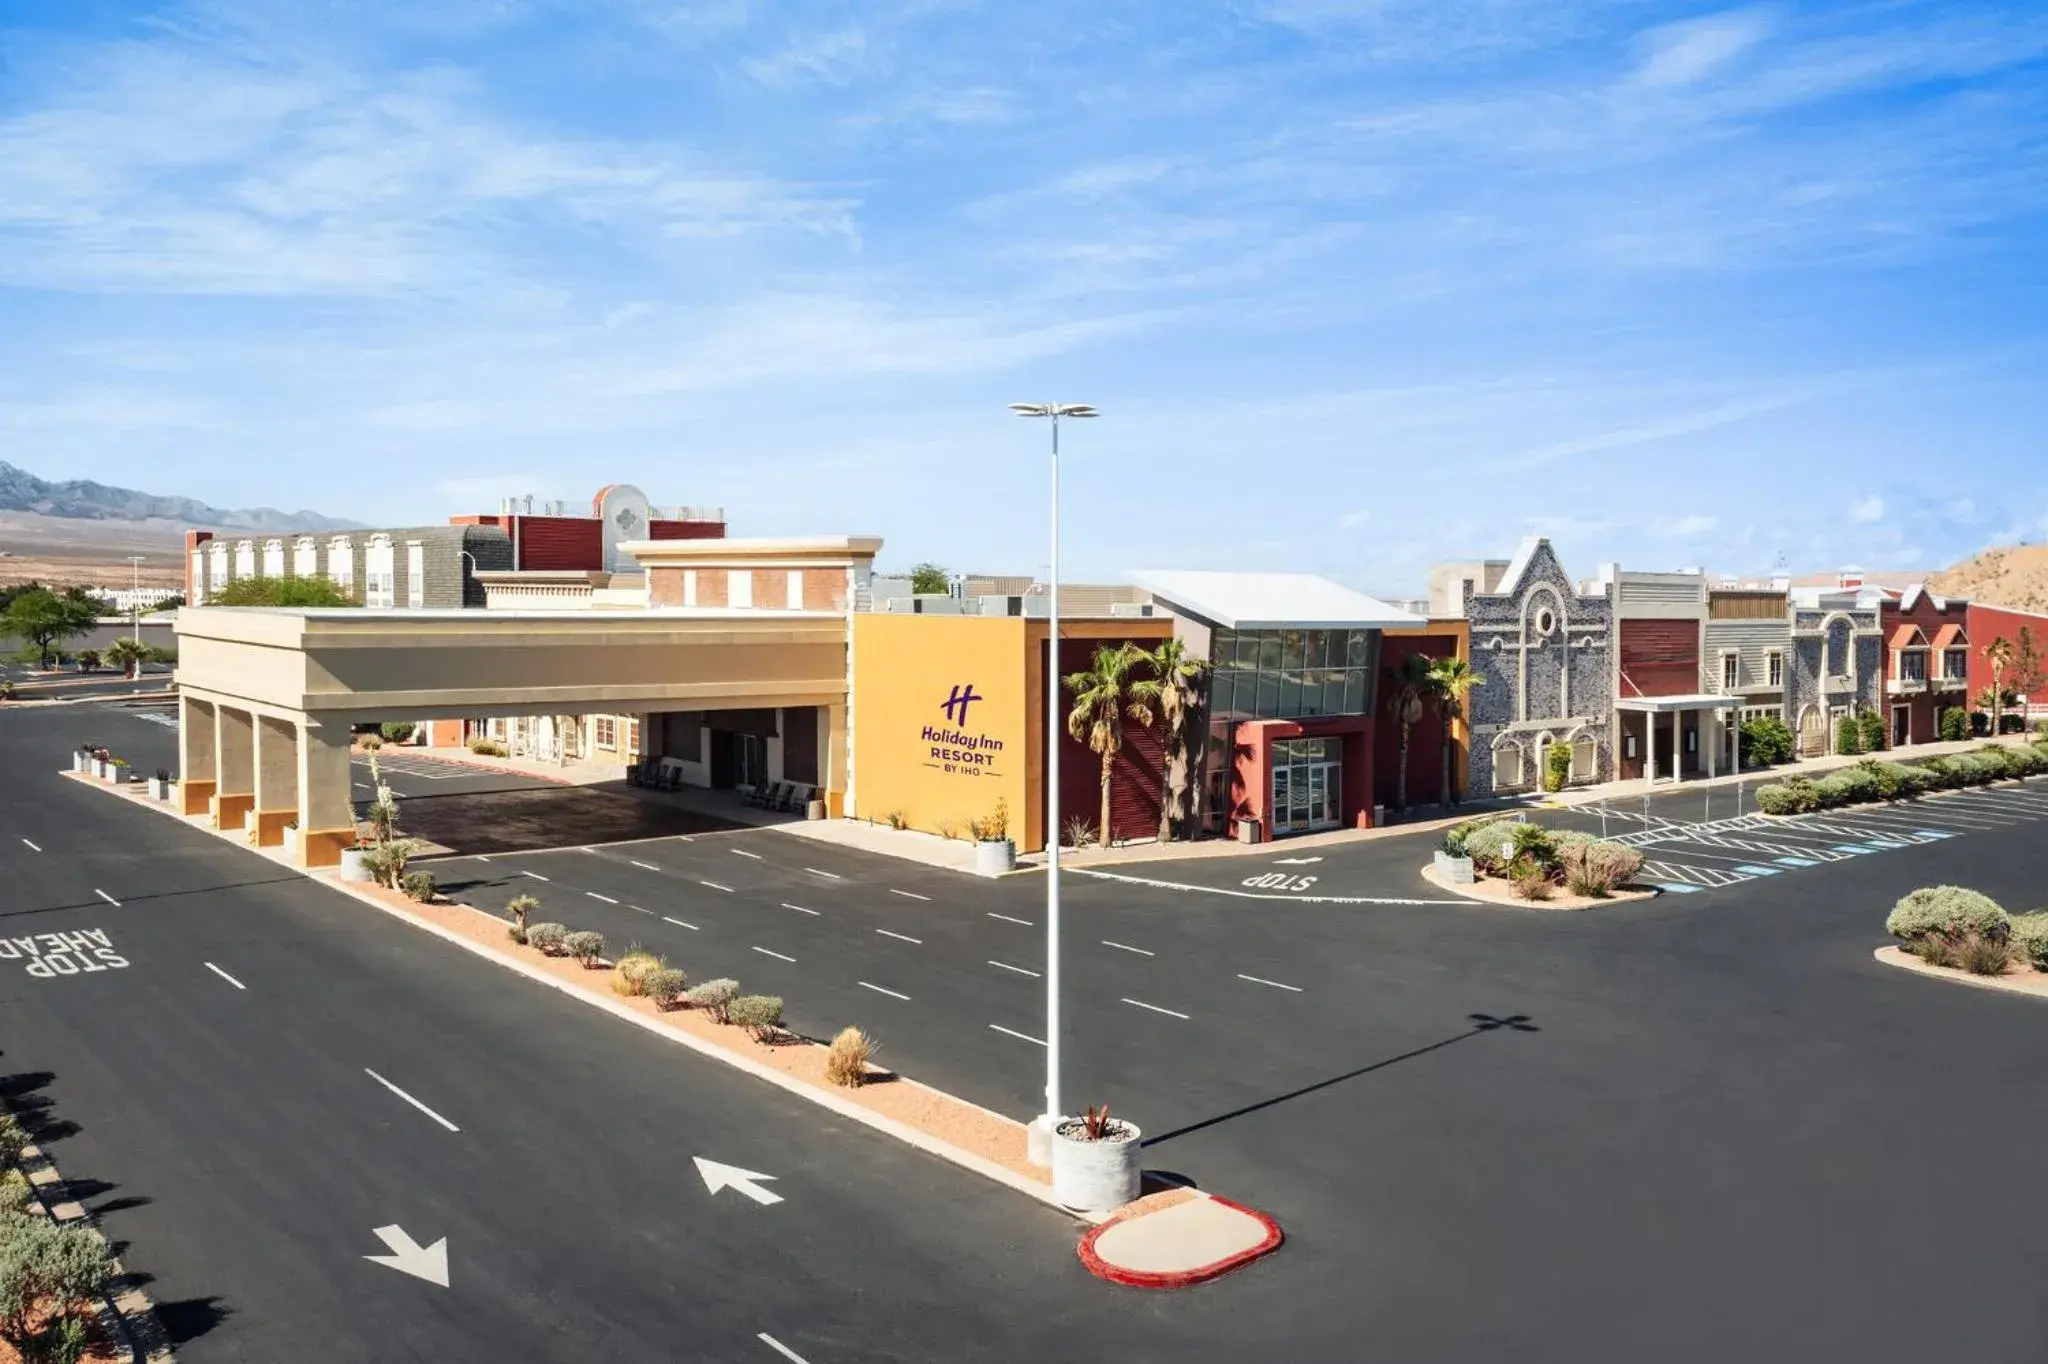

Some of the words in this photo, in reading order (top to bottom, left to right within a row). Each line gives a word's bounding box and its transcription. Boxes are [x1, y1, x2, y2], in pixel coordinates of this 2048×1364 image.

[921, 726, 977, 750] Holiday
[980, 734, 1004, 751] Inn
[931, 747, 995, 766] RESORT
[944, 763, 957, 773] BY
[1241, 872, 1318, 891] STOP
[0, 928, 113, 958] AHEAD
[25, 948, 130, 977] STOP
